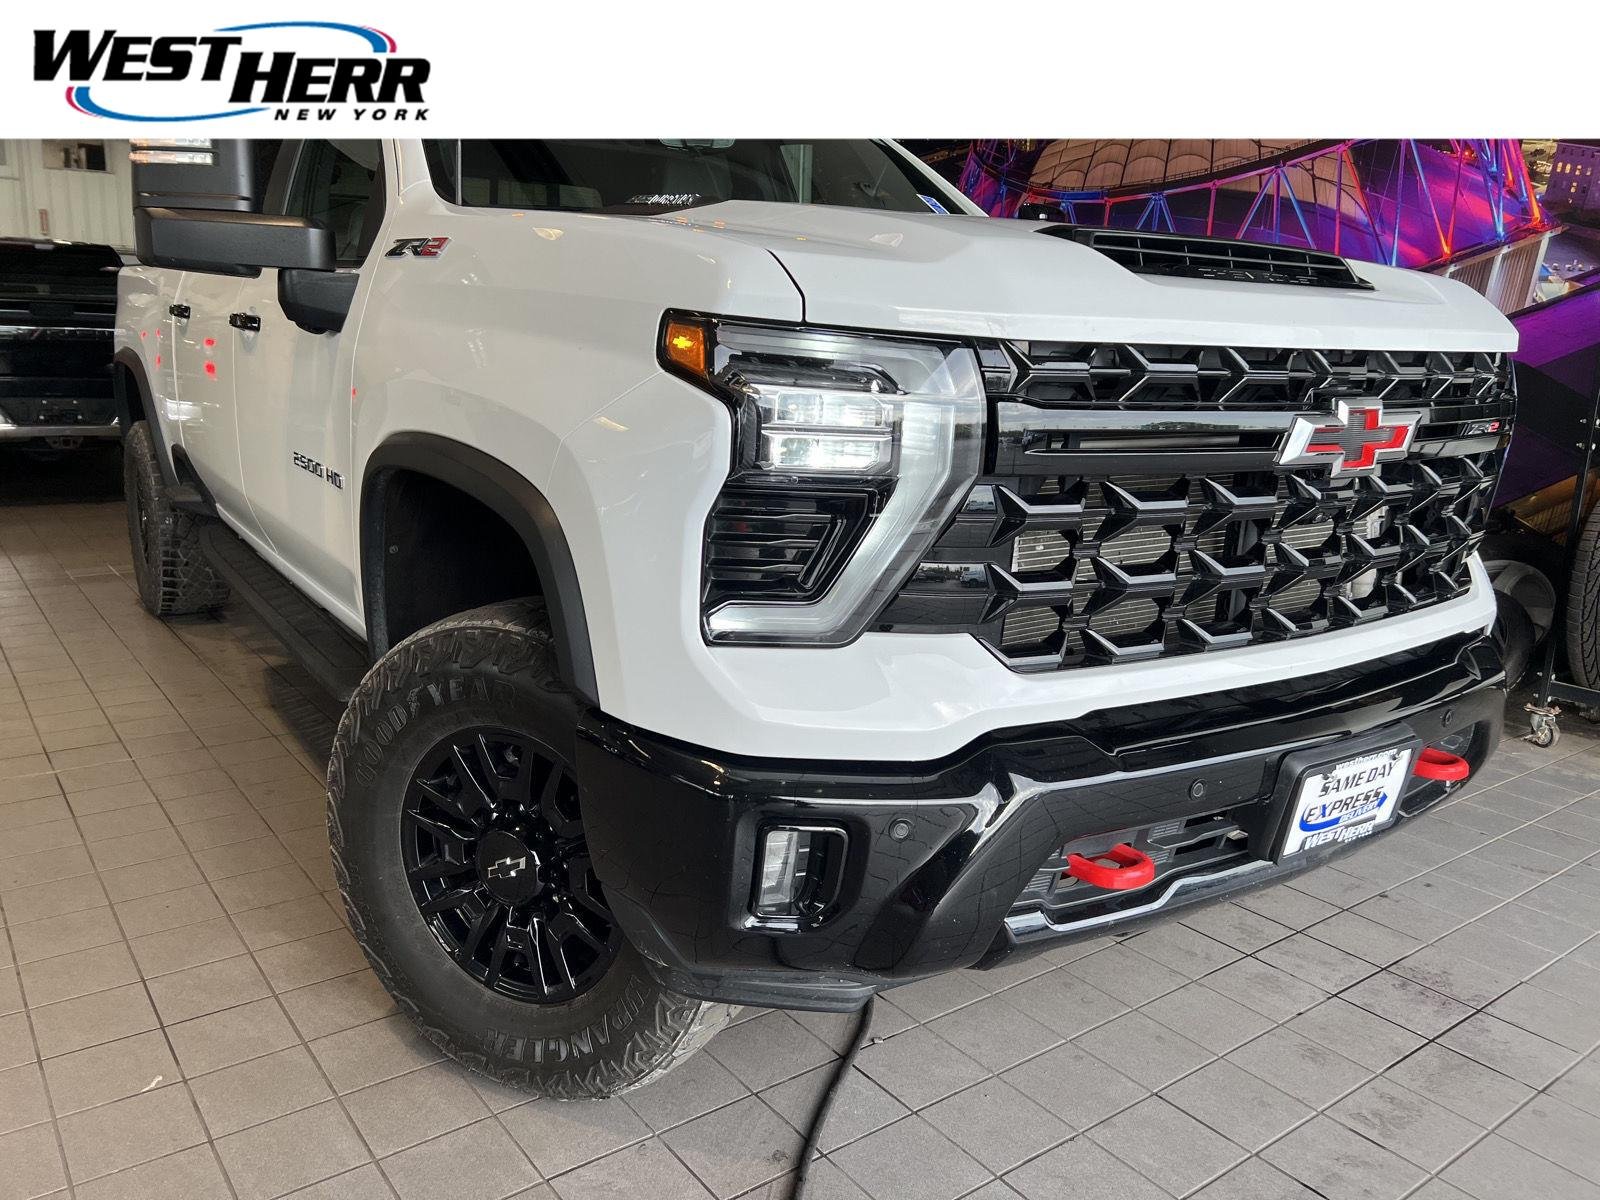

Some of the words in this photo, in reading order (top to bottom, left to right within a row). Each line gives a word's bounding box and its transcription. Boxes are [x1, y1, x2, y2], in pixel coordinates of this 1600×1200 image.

[384, 237, 452, 258] ZR2
[293, 451, 324, 479] 2500
[326, 467, 344, 490] HD
[1318, 771, 1367, 798] SAME
[1365, 760, 1399, 784] DAY
[1304, 786, 1384, 823] EXPRESS
